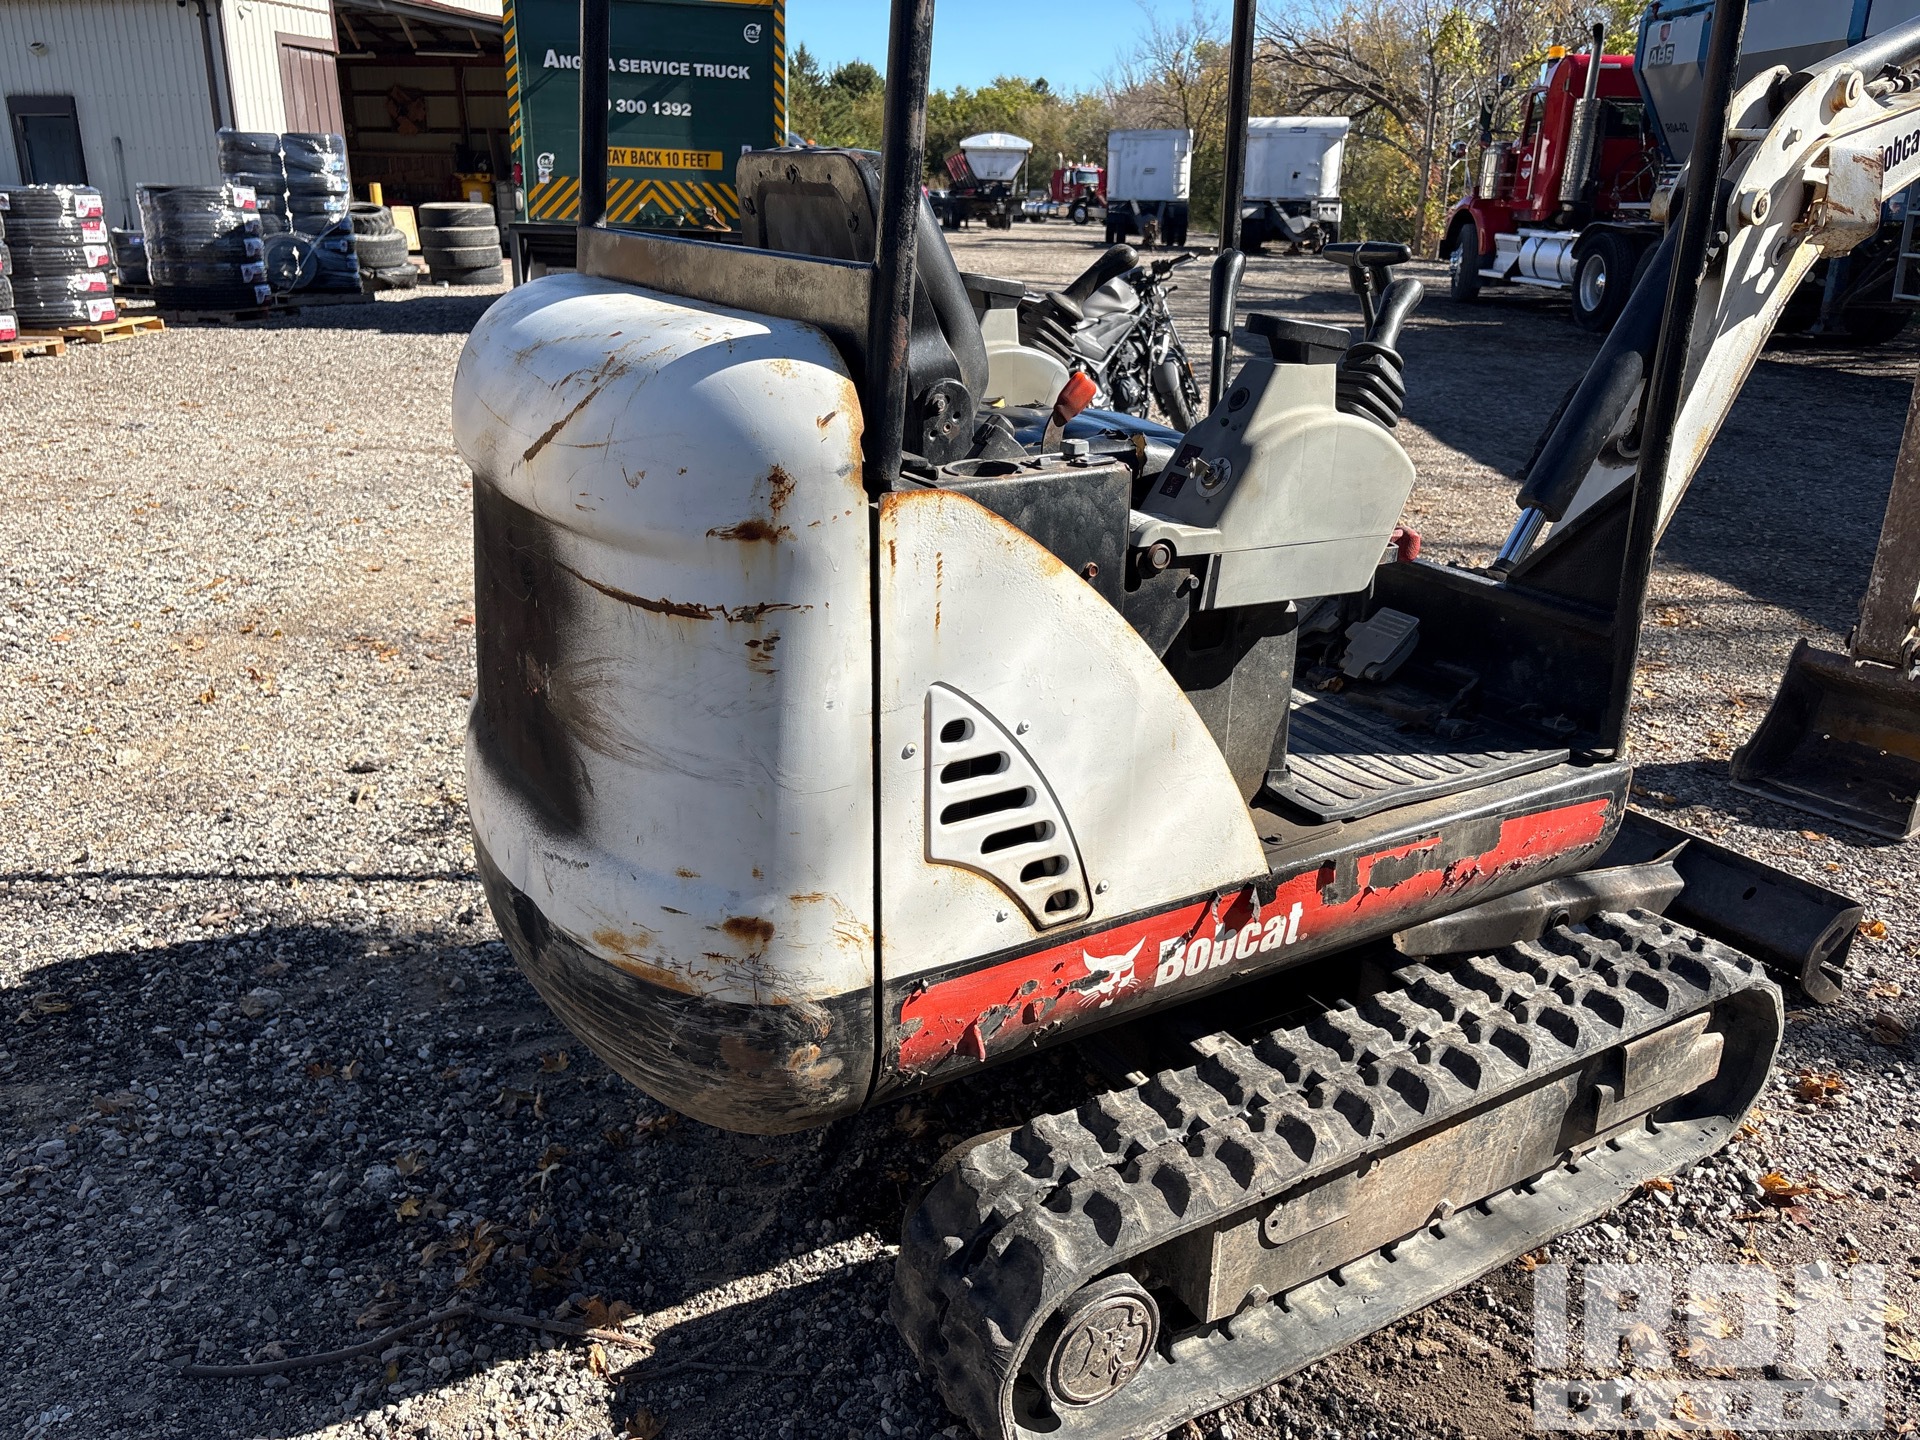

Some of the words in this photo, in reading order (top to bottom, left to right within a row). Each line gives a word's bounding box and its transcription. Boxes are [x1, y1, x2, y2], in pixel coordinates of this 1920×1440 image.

[543, 49, 615, 72] ANGA
[619, 58, 690, 76] SERVICE
[693, 63, 751, 80] TRUCK
[1649, 46, 1674, 66] ABS
[616, 98, 647, 114] 300
[652, 102, 692, 117] 1392
[608, 149, 627, 165] TAY
[631, 150, 662, 165] BACK
[665, 152, 679, 166] 10
[683, 153, 711, 168] FEET
[1879, 129, 1920, 172] obca
[1154, 902, 1304, 988] Bobcat
